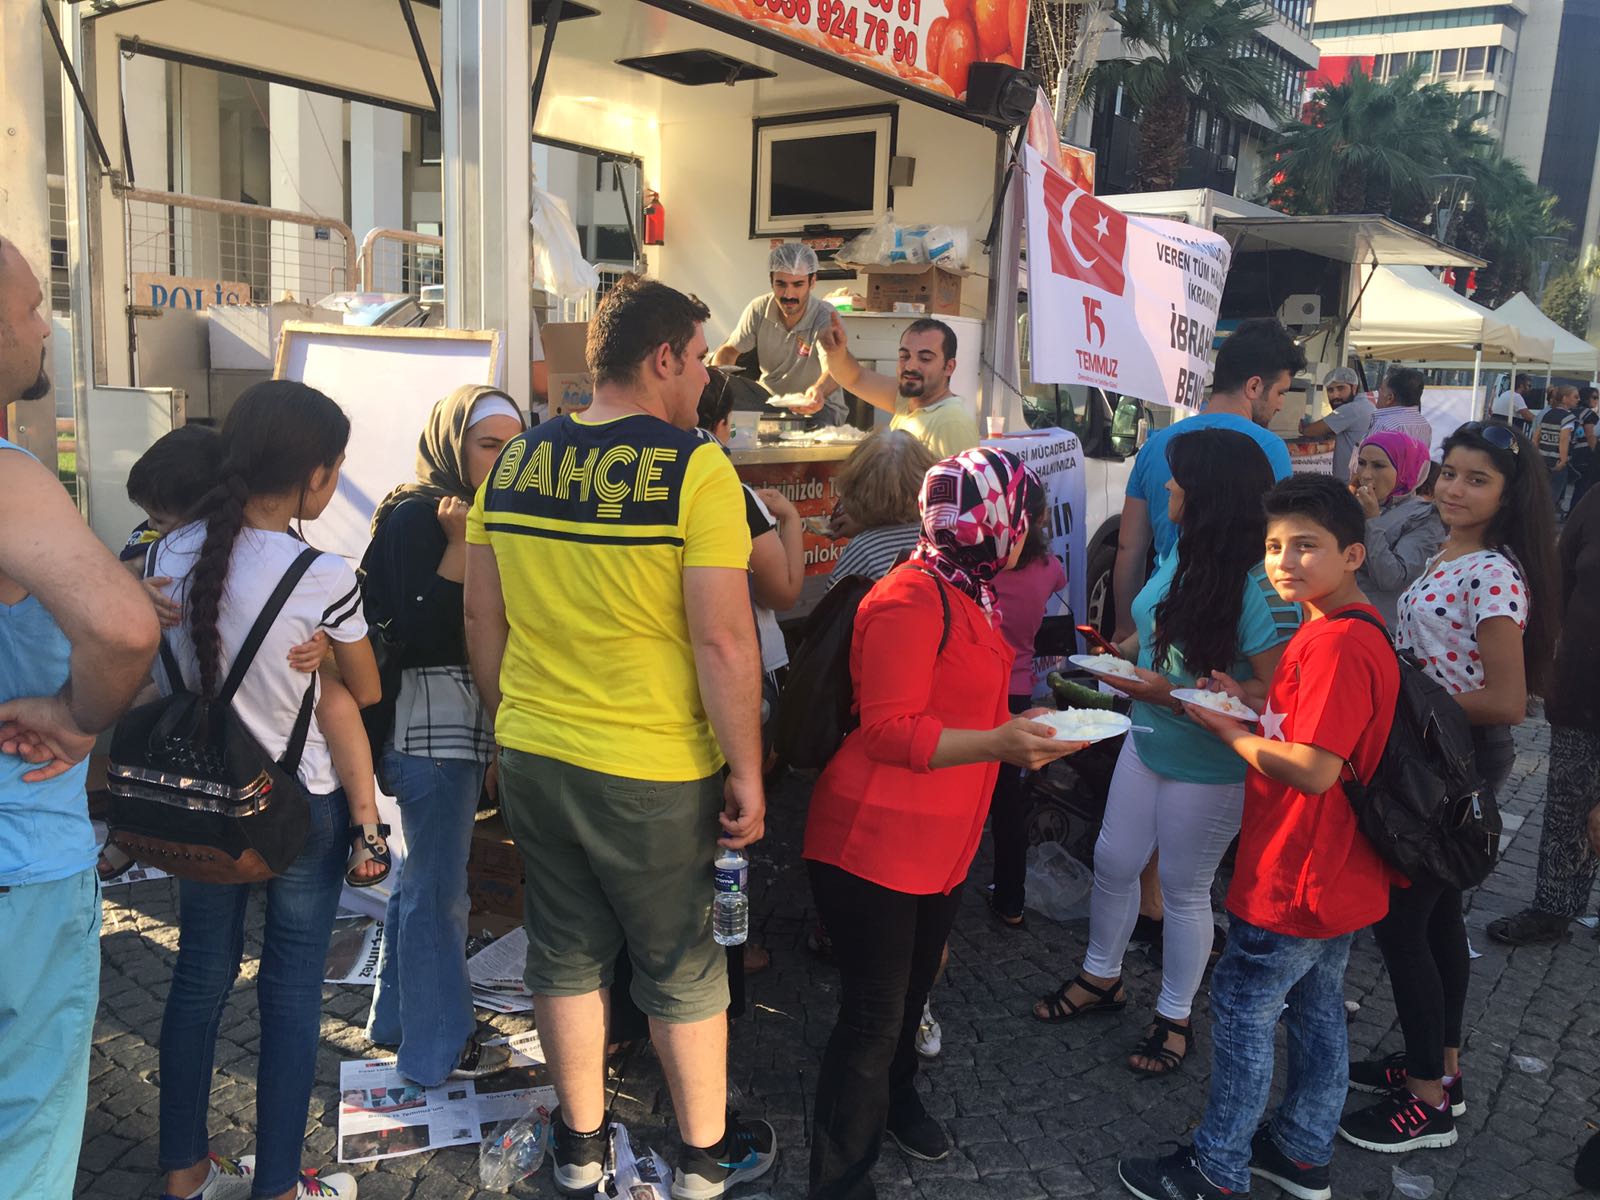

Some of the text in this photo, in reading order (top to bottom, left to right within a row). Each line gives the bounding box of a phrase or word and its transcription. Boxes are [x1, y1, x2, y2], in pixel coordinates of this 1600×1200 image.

[817, 0, 858, 43] 924
[864, 12, 889, 55] 76
[893, 26, 918, 67] 90
[1157, 242, 1191, 272] VEREN
[1193, 257, 1210, 282] TÜM
[1082, 296, 1105, 349] 15
[1075, 349, 1118, 378] TEMMUZ
[492, 438, 678, 519] BAHÇE
